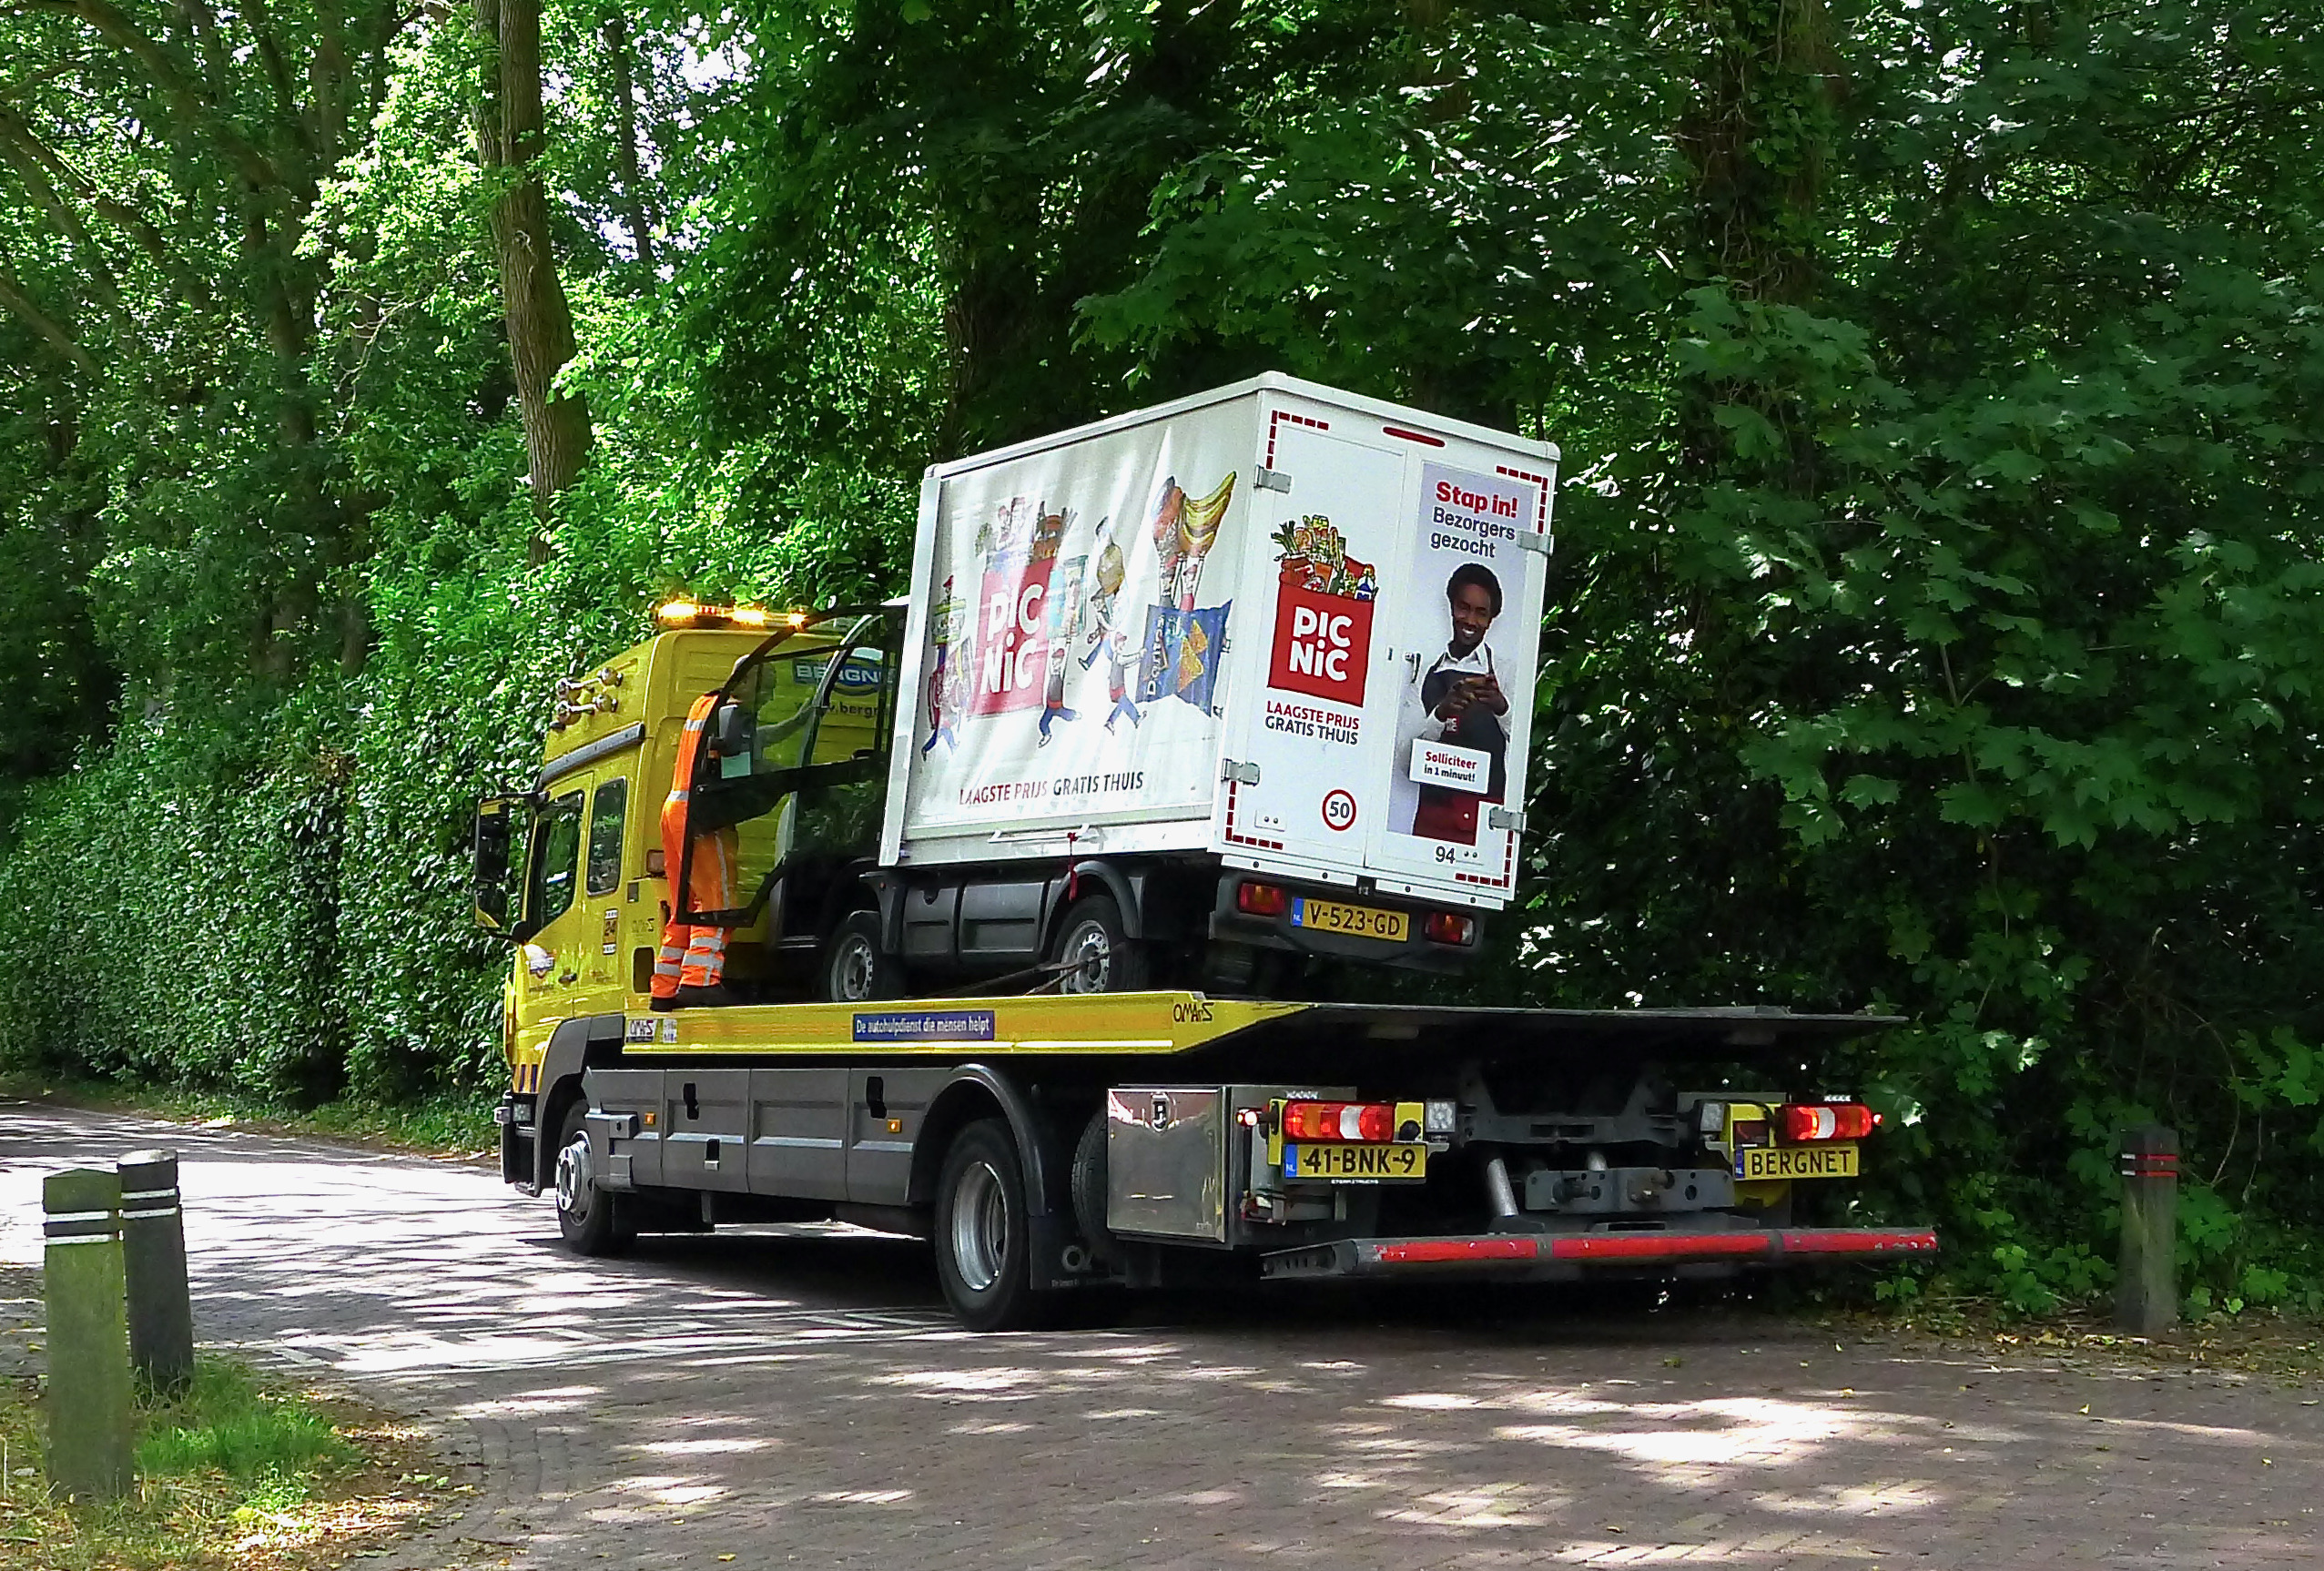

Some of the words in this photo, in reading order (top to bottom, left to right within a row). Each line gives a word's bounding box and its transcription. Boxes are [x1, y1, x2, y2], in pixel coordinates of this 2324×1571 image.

[1436, 481, 1488, 513] Stap
[1492, 494, 1517, 518] in!
[1433, 506, 1515, 540] Bezorgers
[1430, 532, 1496, 558] gezocht
[987, 583, 1044, 641] PIC
[1293, 606, 1353, 647] PIC
[1266, 700, 1324, 723] LAAGSTE
[1326, 713, 1359, 729] PRIJS
[1265, 715, 1314, 736] GRATIS
[1317, 725, 1358, 745] THUIS
[1424, 764, 1433, 774] in
[1435, 767, 1439, 775] 1
[1441, 768, 1476, 782] minuut!
[1426, 751, 1477, 769] Solliciteer
[959, 785, 1010, 805] LAAGSTE
[1014, 781, 1047, 799] PRIJS
[1053, 775, 1099, 796] GRATIS
[1103, 772, 1143, 792] THUIS
[1329, 801, 1350, 818] 50
[1436, 846, 1456, 864] 94
[1309, 903, 1400, 936] V-523-GD
[856, 1019, 867, 1033] De
[868, 1018, 921, 1036] autohulpdienst
[923, 1017, 935, 1032] die
[969, 1016, 989, 1036] helpt
[1303, 1148, 1416, 1173] 41-BNK-9
[1751, 1150, 1852, 1176] BERGNET
